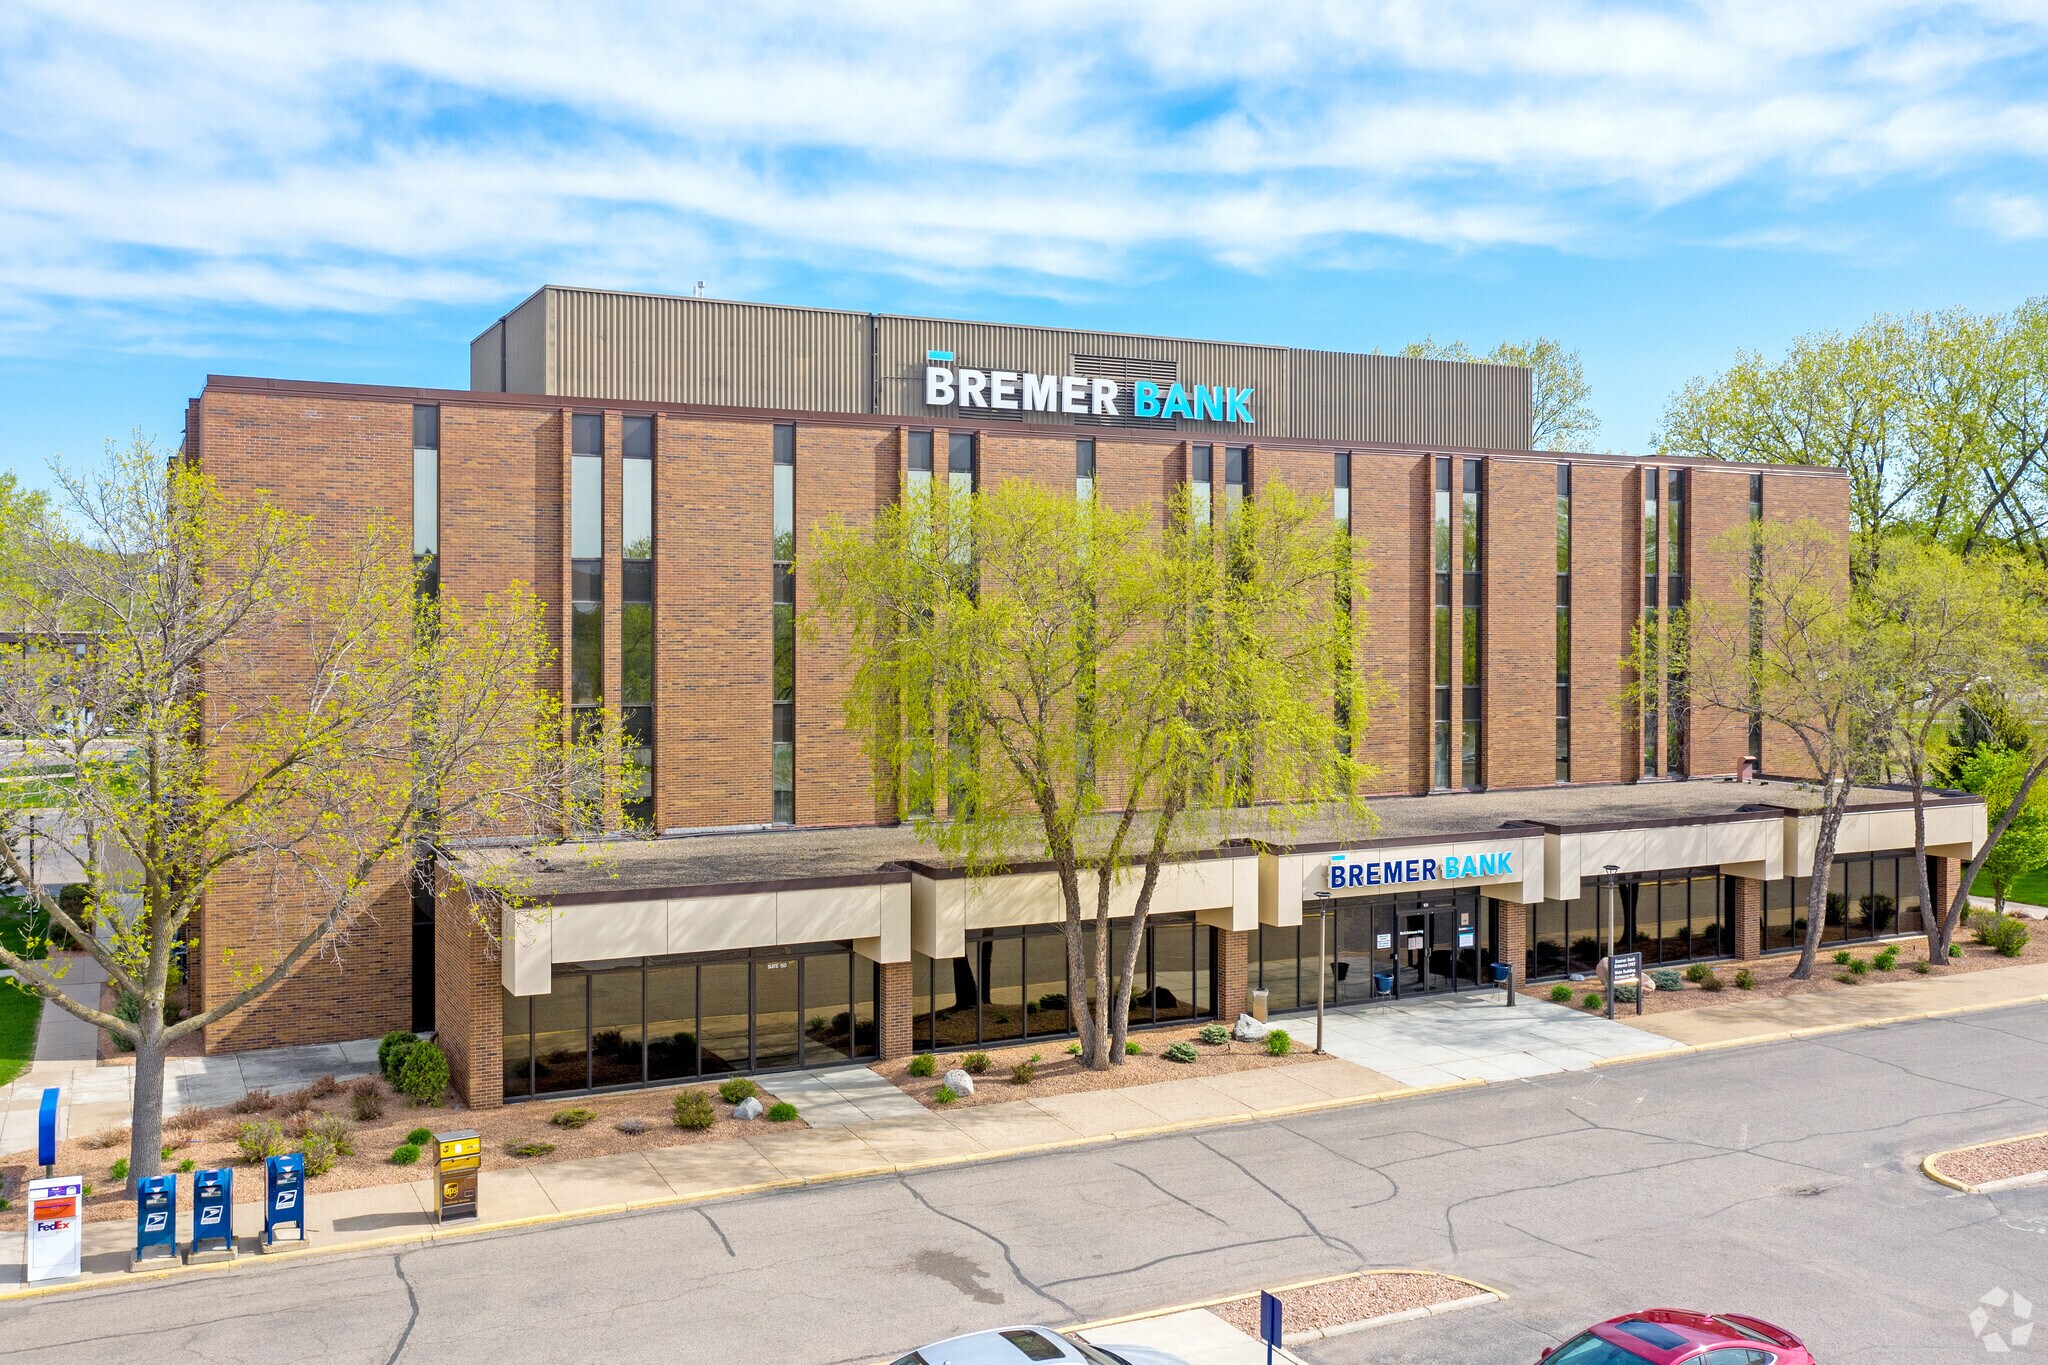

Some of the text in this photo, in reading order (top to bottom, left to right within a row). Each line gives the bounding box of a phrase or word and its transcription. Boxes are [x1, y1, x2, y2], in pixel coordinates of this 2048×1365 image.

[926, 366, 1255, 424] BREMER BANK
[1329, 851, 1513, 889] BREMER BANK
[38, 1220, 70, 1232] FedEx
